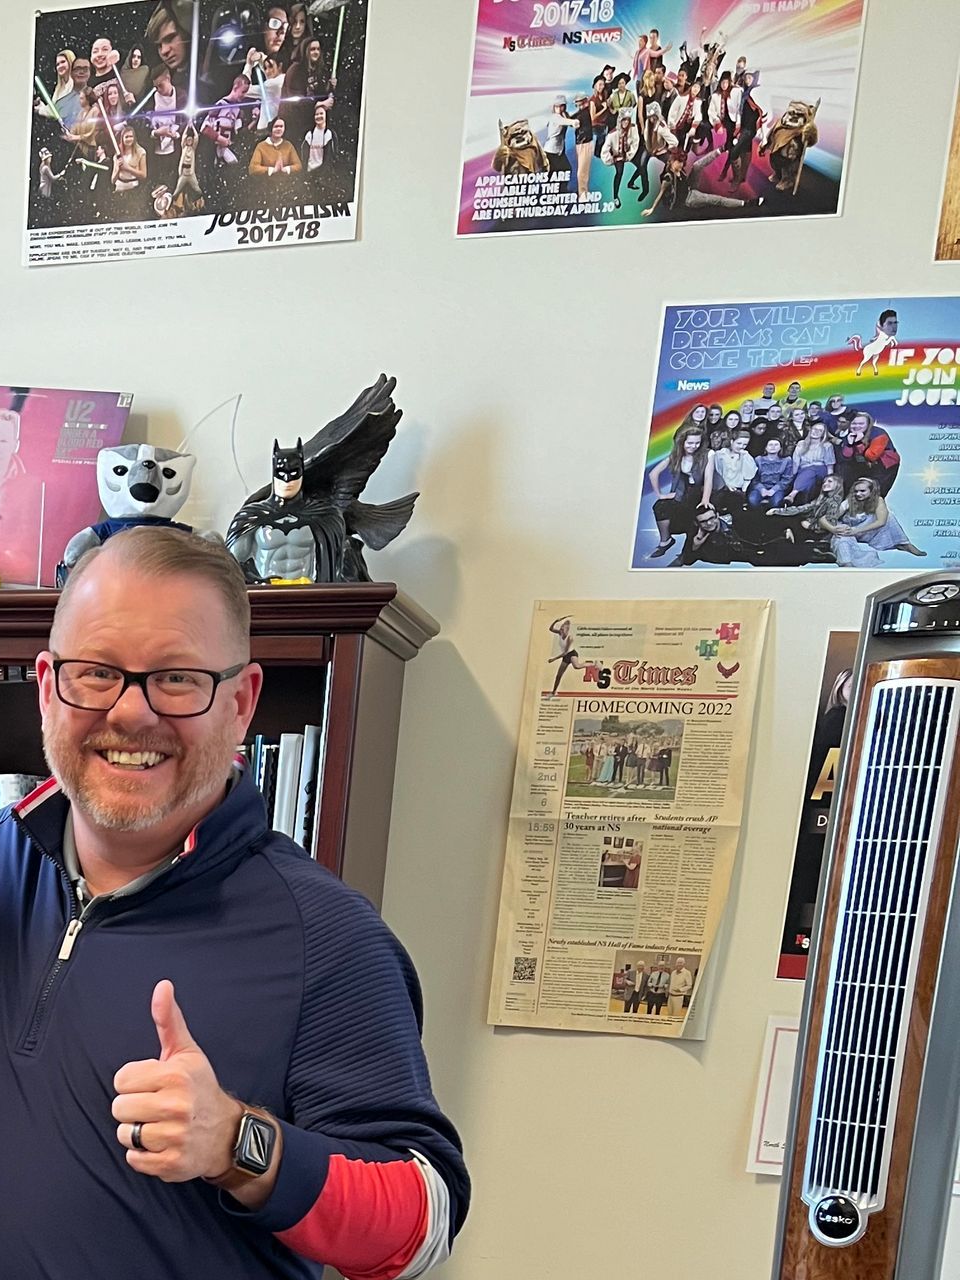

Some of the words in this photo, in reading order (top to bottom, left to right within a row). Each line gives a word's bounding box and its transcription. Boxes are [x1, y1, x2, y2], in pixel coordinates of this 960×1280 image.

[530, 0, 614, 28] 2017-18
[475, 173, 548, 187] APPLICATIONS
[550, 170, 570, 182] ARE
[474, 186, 527, 198] AVAILABLE
[528, 185, 540, 195] IN
[541, 183, 560, 194] THE
[474, 196, 538, 210] COUNSELING
[540, 193, 577, 205] CENTER
[578, 192, 602, 203] AND
[204, 203, 352, 235] JOURNALISM
[472, 210, 492, 221] ARE
[493, 208, 514, 220] DUE
[516, 204, 568, 218] THURSDAY,
[570, 203, 600, 214] APRIL
[237, 220, 321, 244] 2017-18
[674, 308, 740, 328] YOUR
[750, 304, 859, 326] WILDEST
[672, 328, 772, 350] DREAMS
[781, 326, 832, 346] CAN
[670, 350, 740, 370] COME
[888, 348, 915, 366] IF
[902, 368, 957, 385] JOIN
[677, 380, 710, 391] News
[896, 388, 960, 406] JOUR
[64, 400, 96, 422] U2
[583, 660, 612, 690] NS
[612, 660, 698, 686] Times
[576, 700, 693, 715] HOMECOMING
[698, 702, 732, 716] 2022
[544, 746, 556, 756] 84
[537, 772, 557, 782] 2nd
[566, 812, 598, 820] Teacher
[600, 813, 626, 821] retires
[627, 814, 646, 822] after
[654, 813, 684, 822] Students
[564, 822, 574, 830] 30
[576, 824, 596, 832] years
[606, 824, 621, 832] NS
[652, 824, 682, 832] national
[683, 826, 712, 834] average
[548, 938, 566, 947] Newly
[567, 939, 597, 947] established
[666, 944, 678, 952] first
